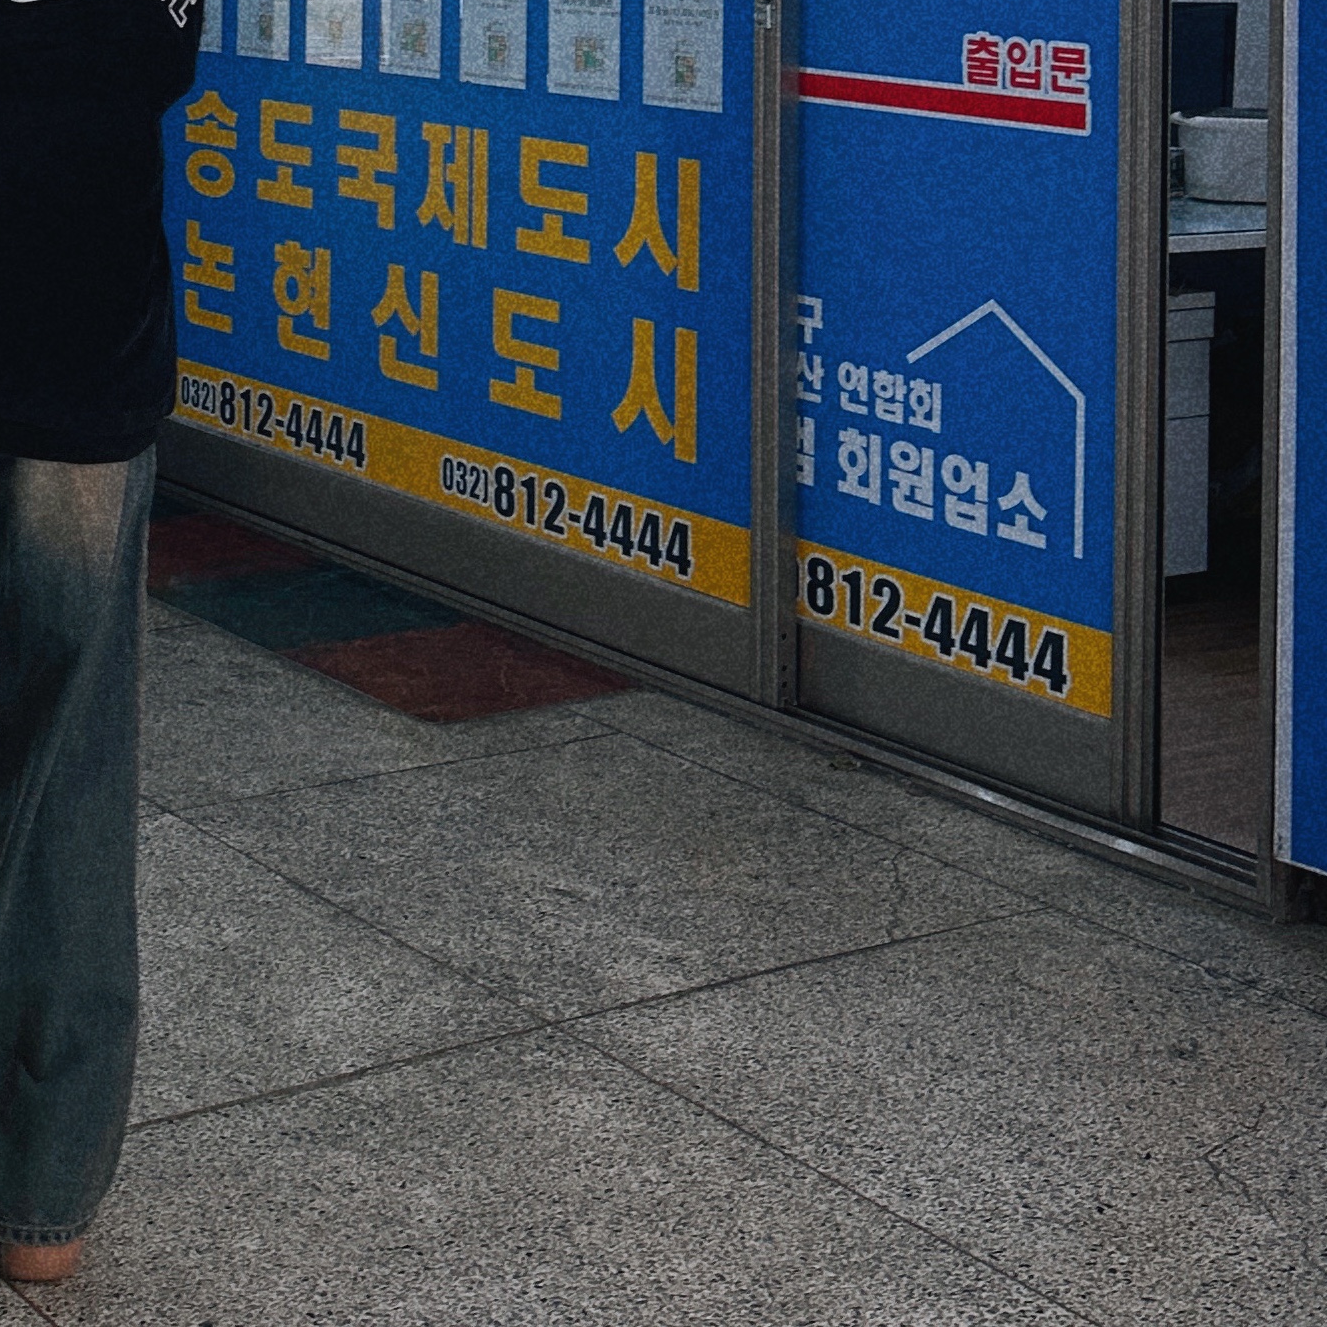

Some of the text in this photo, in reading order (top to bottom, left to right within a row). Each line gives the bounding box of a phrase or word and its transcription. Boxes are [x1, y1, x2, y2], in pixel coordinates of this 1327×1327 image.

[964, 33, 1089, 96] 출입문
[184, 89, 702, 292] 송도국제도시
[183, 219, 698, 465] 논현신도시
[837, 361, 942, 434] 연합회
[181, 376, 365, 468] 032)812-4444
[442, 456, 692, 577] 032)812-4444
[837, 427, 1049, 550] 회원업소
